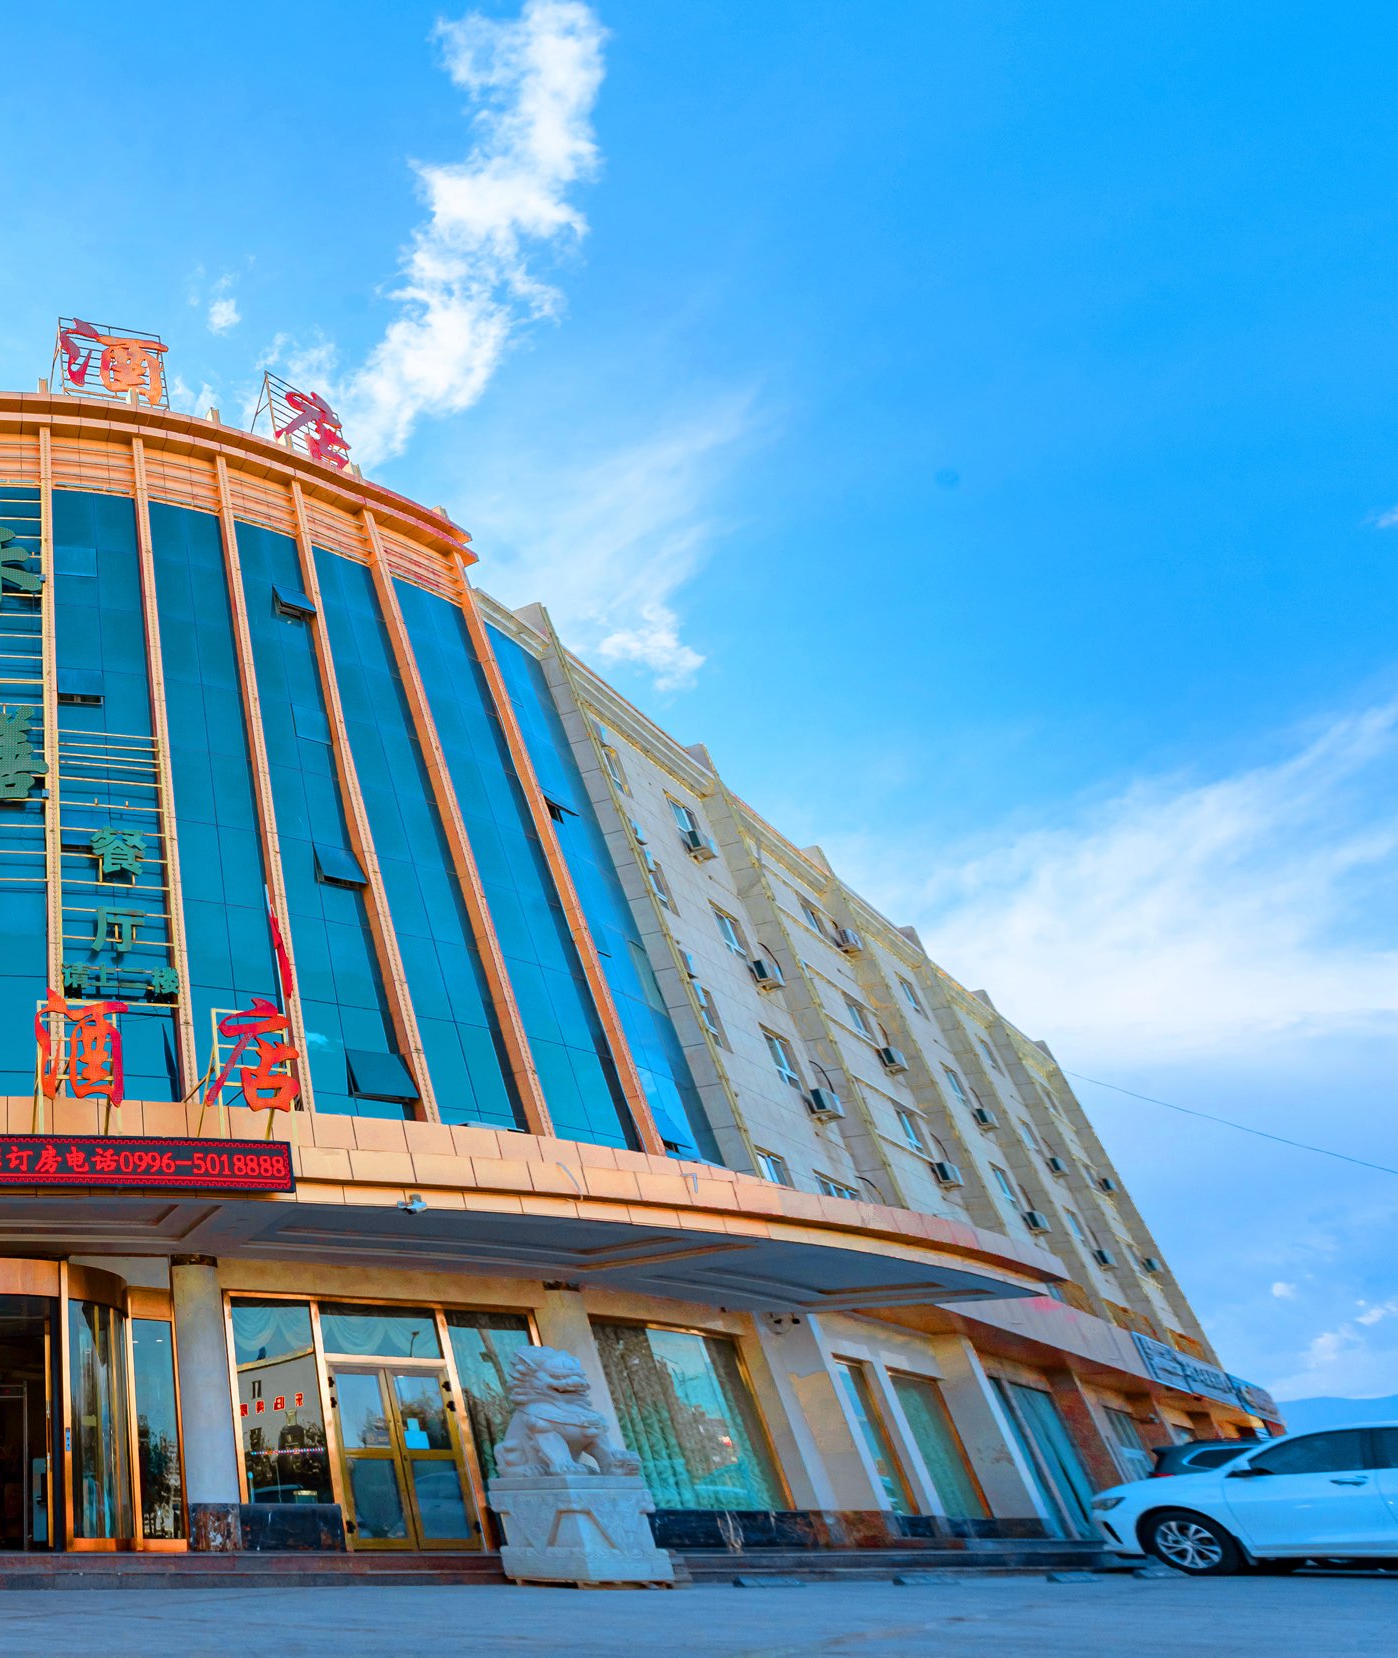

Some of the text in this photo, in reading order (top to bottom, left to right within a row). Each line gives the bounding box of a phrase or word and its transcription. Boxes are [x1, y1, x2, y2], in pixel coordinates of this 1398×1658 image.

[90, 826, 147, 954] 餐厅
[61, 961, 180, 995] 请上二楼
